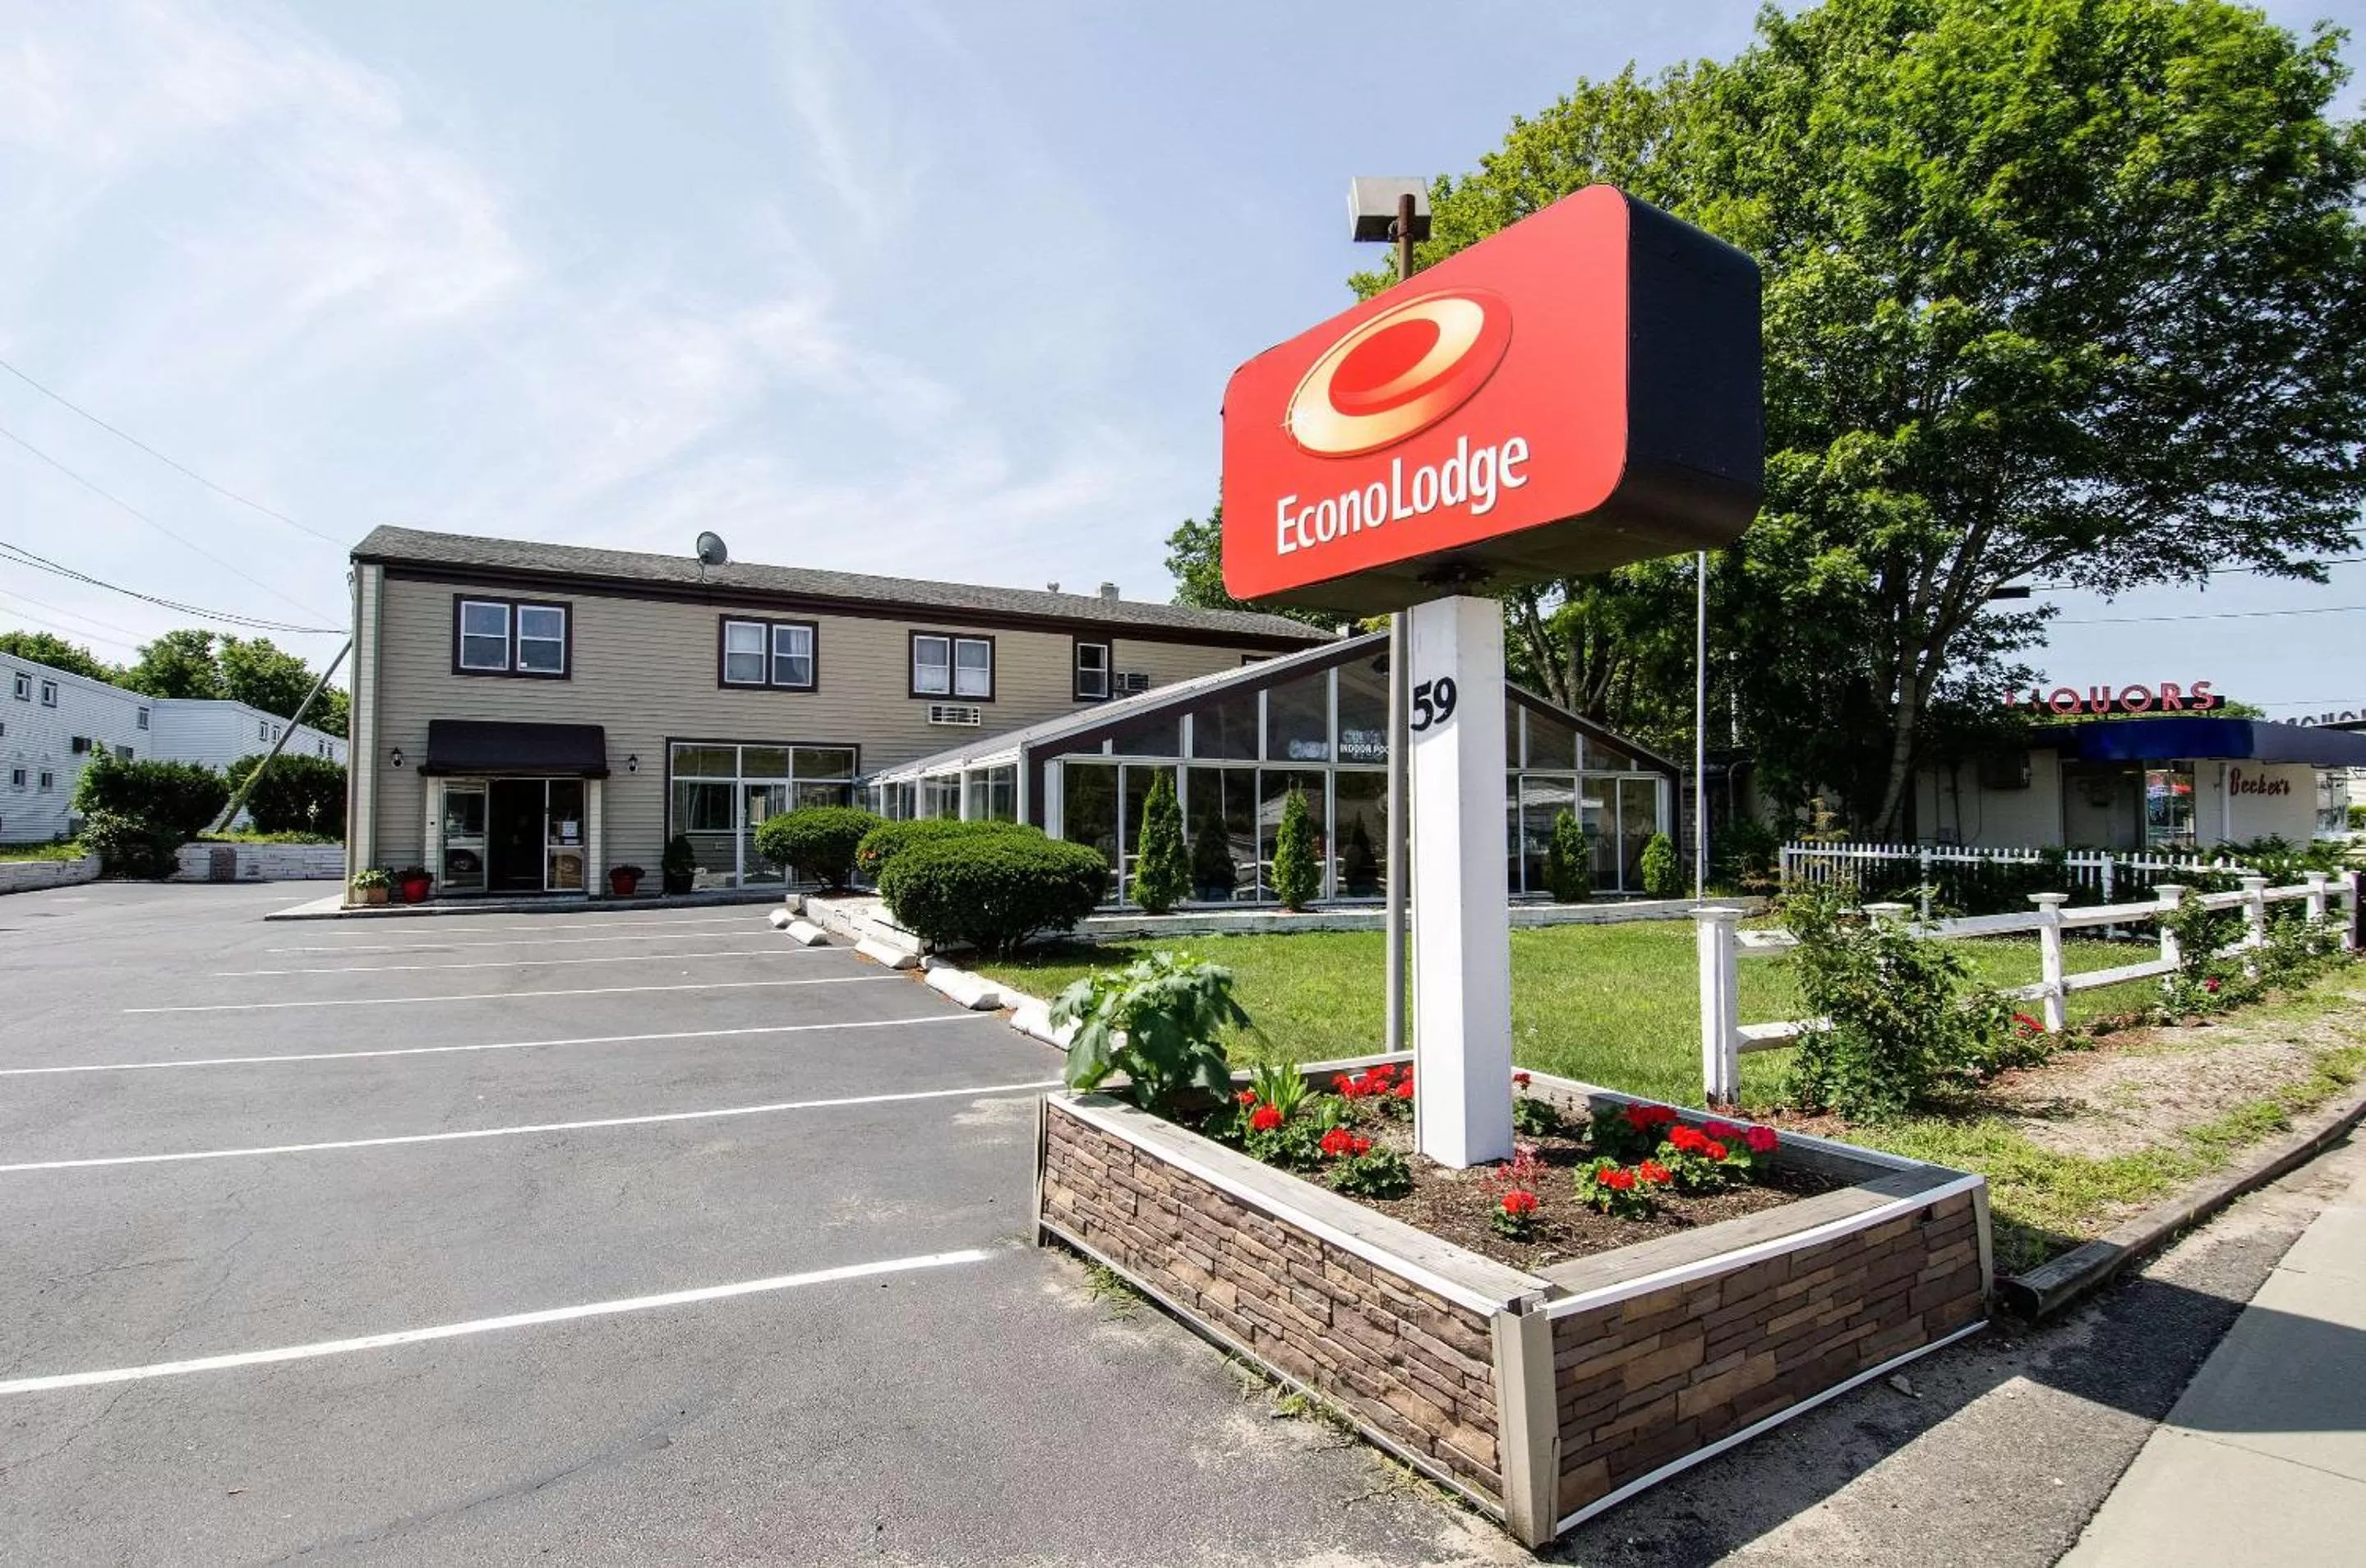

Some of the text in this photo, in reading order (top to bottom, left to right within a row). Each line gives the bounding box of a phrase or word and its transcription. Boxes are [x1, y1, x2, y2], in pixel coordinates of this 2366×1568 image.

[1277, 435, 1529, 556] EconoLodge
[1410, 676, 1457, 731] 59
[1340, 743, 1372, 754] INDOOR
[1373, 743, 1390, 755] POO
